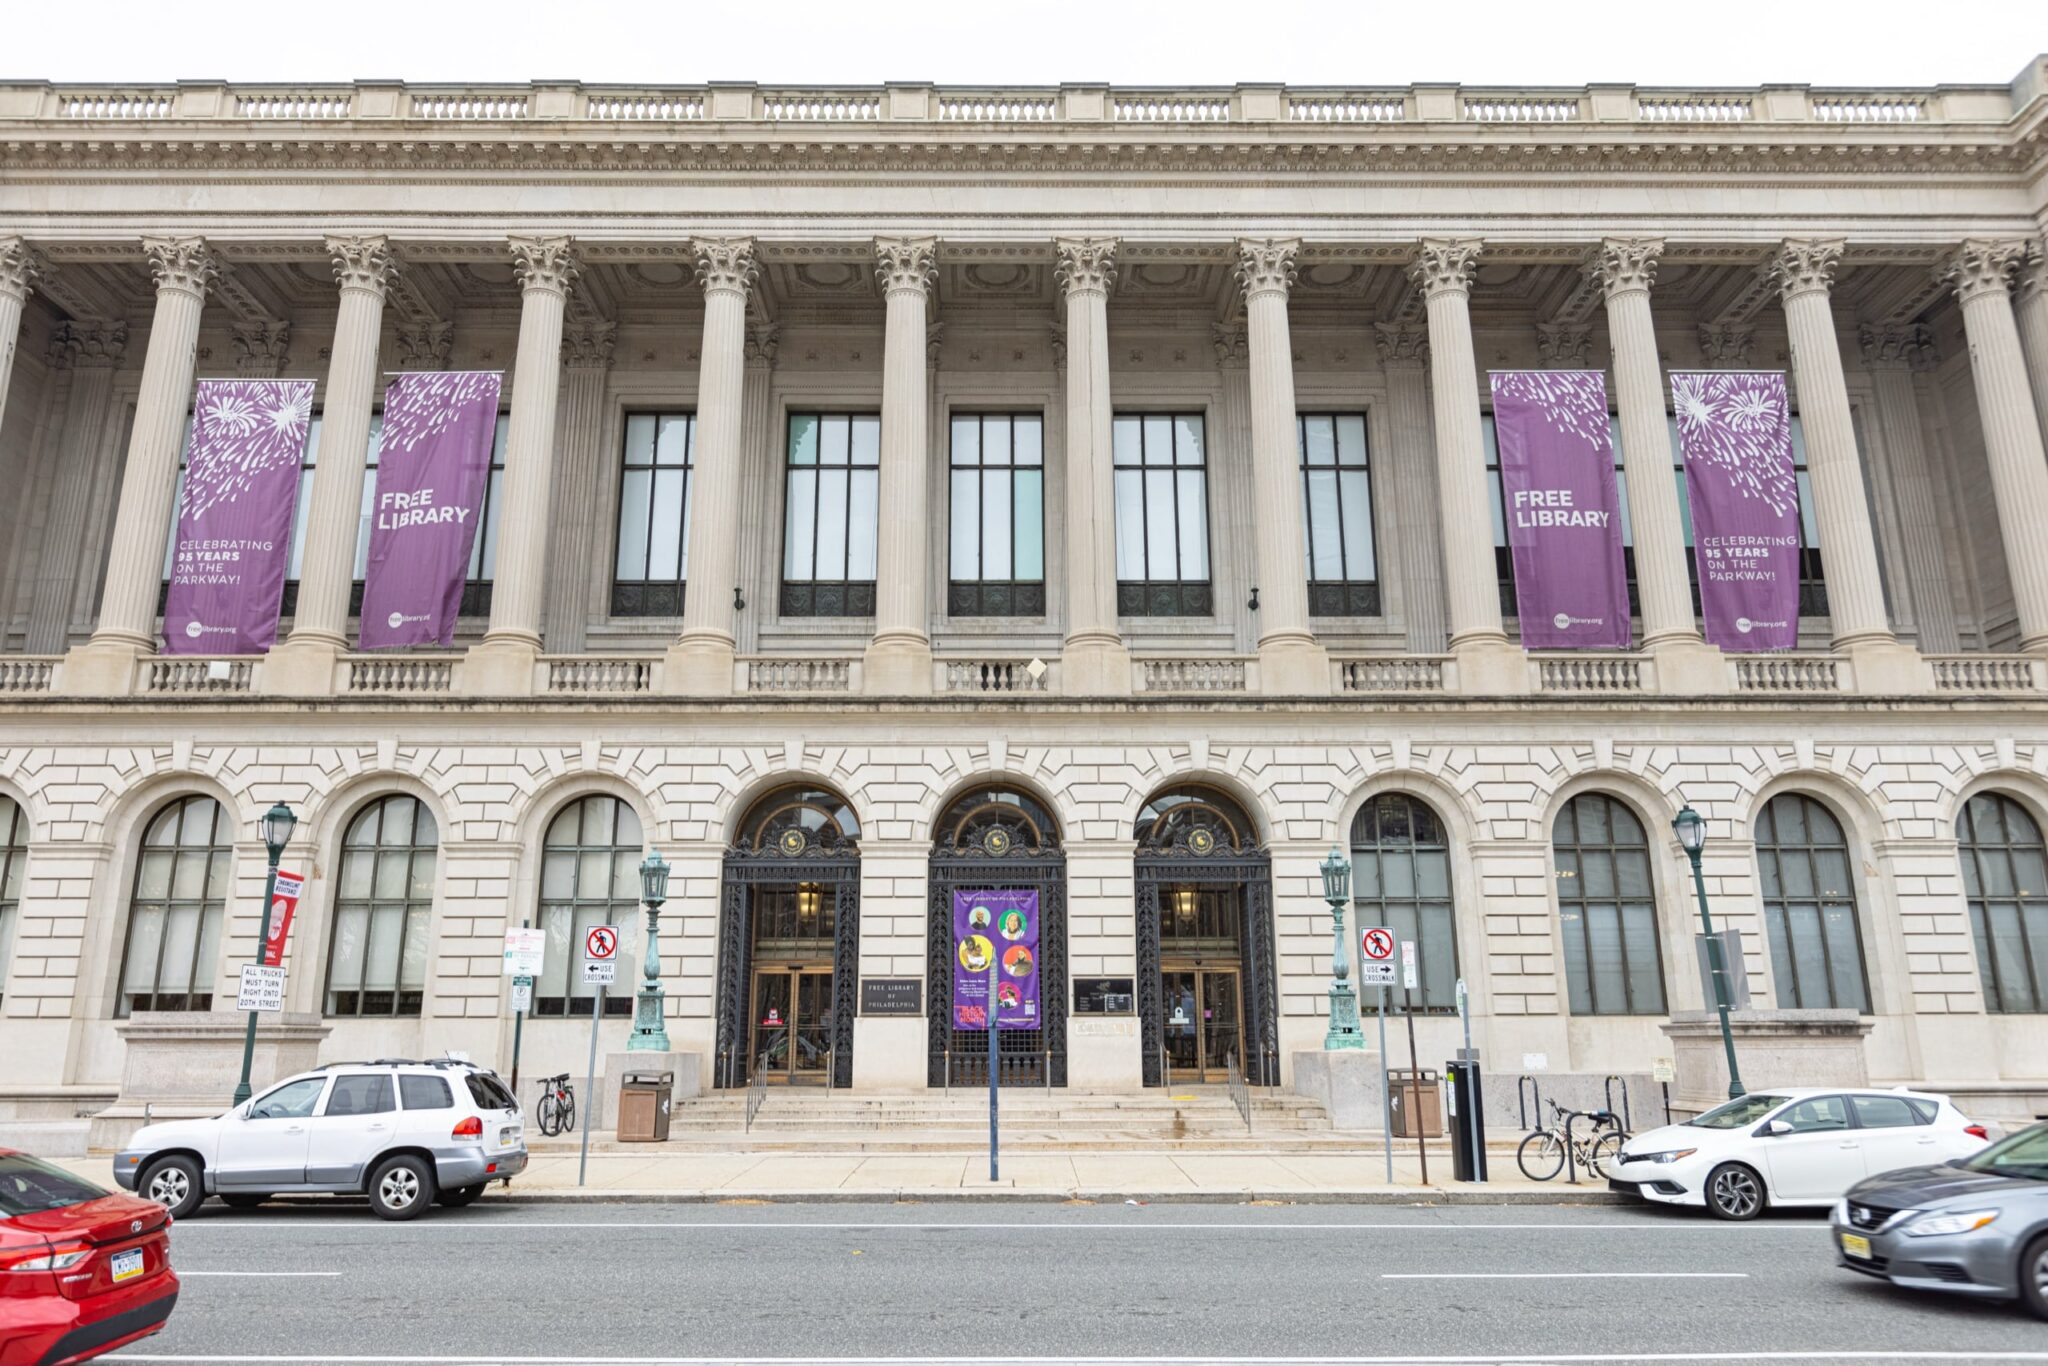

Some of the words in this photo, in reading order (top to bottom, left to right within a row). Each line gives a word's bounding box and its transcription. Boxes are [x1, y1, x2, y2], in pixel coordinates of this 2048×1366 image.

[380, 488, 434, 510] FREE
[1514, 490, 1573, 508] FREE
[378, 506, 470, 530] LIBRARY
[1516, 510, 1609, 528] LIBRARY
[179, 540, 273, 551] CELEBRATING
[1703, 535, 1797, 547] CELEBRATING
[178, 552, 193, 562] 95
[196, 551, 240, 561] YEARS
[1705, 549, 1720, 558] 95
[1725, 547, 1769, 558] YEARS
[176, 563, 194, 574] ON
[198, 562, 224, 573] THE
[1707, 559, 1726, 569] ON
[1731, 559, 1758, 569] THE
[174, 575, 241, 585] PARKWAY!
[1709, 571, 1776, 581] PARKWAY!
[260, 969, 283, 978] TRUCKS
[584, 973, 614, 981] CROSSWALK
[1365, 974, 1395, 982] CROSSWALK
[243, 988, 261, 996] RIGHT
[263, 989, 279, 997] ONTO
[239, 998, 256, 1006] 20TH
[258, 999, 280, 1008] STREET
